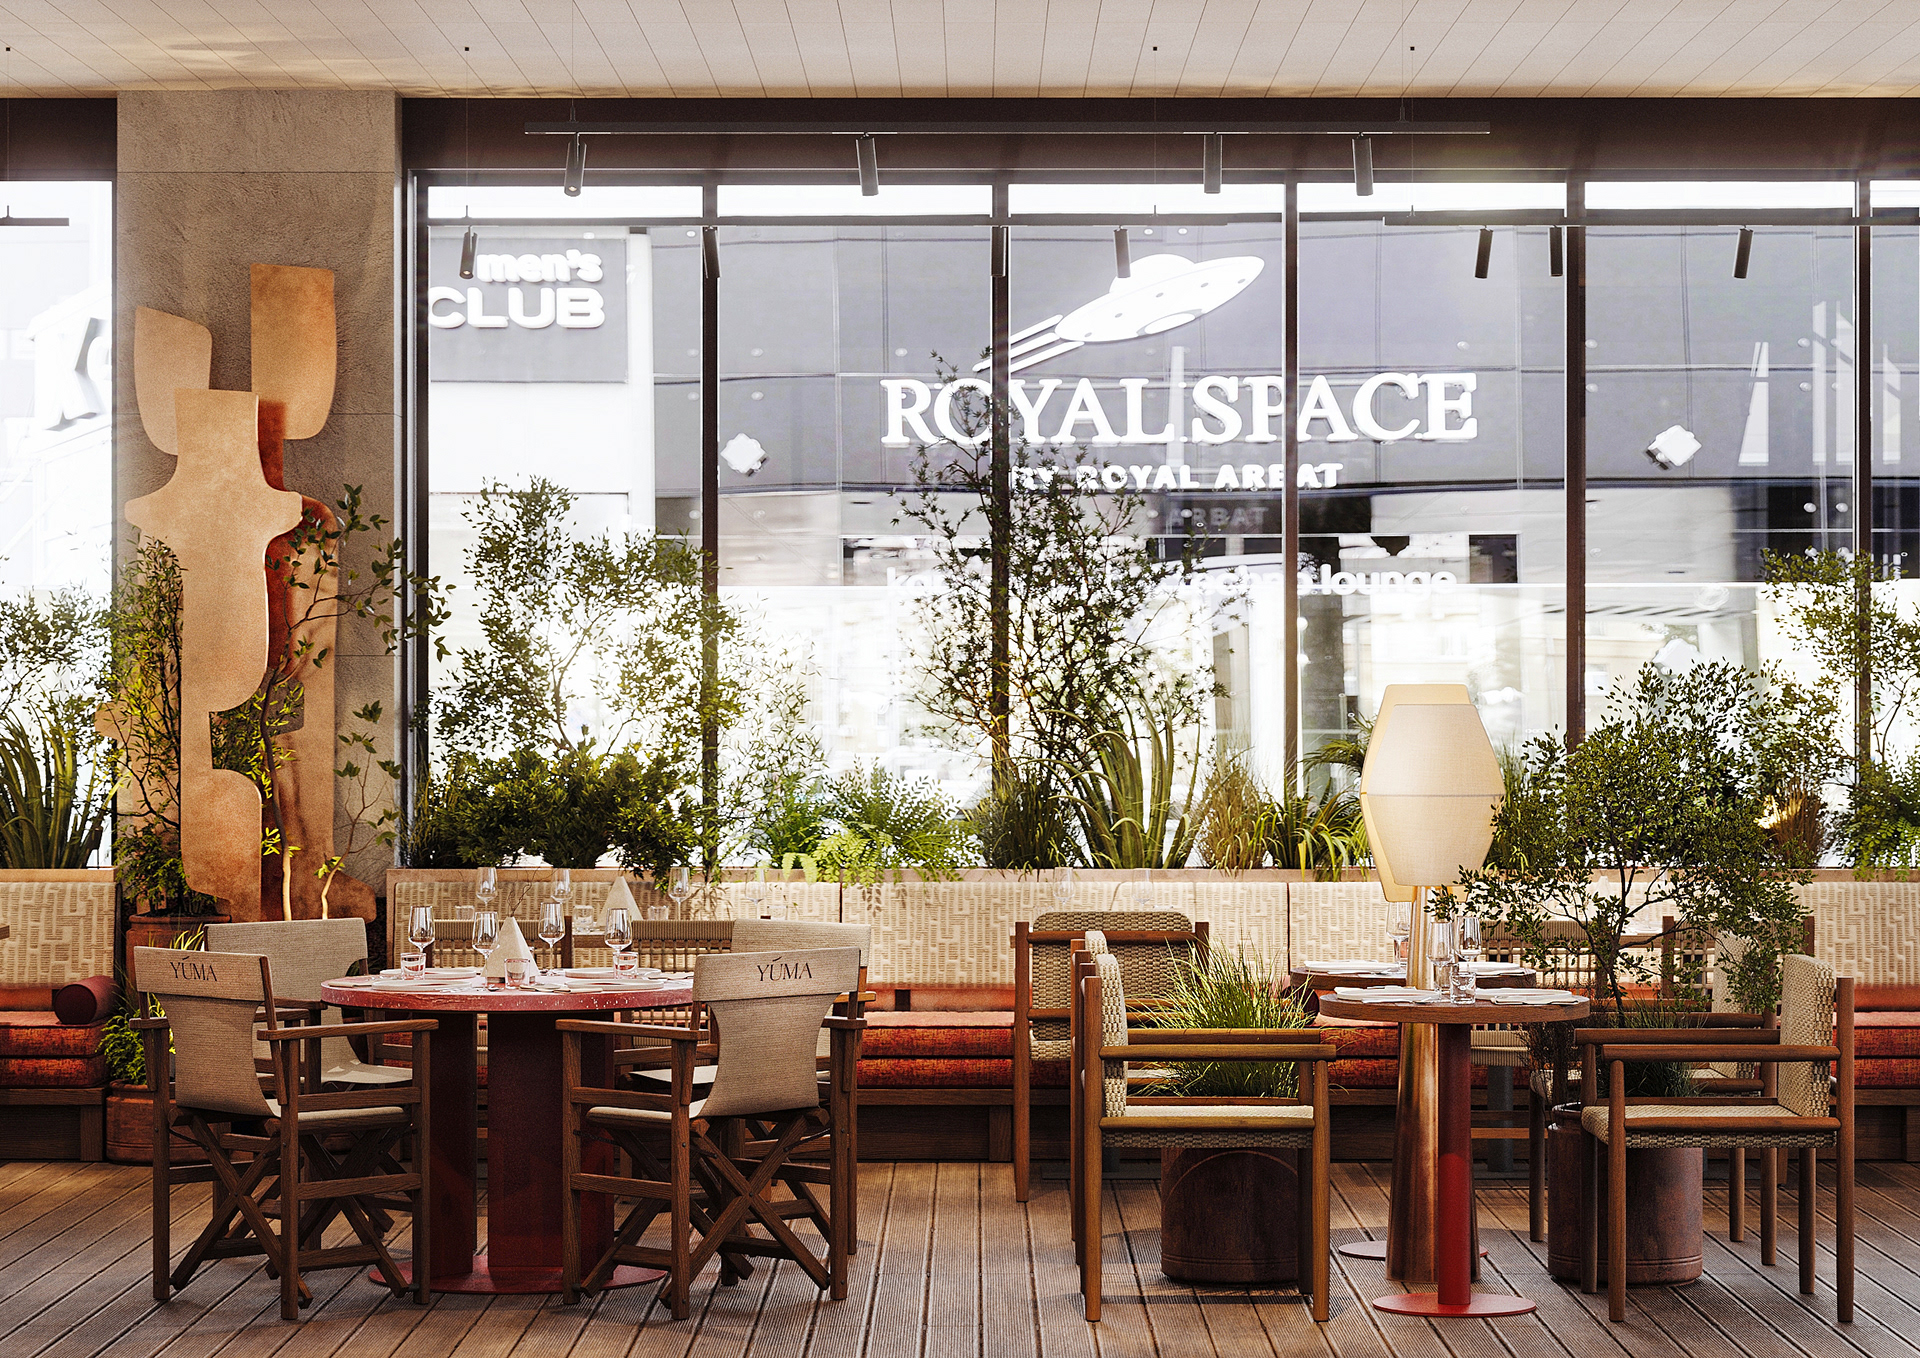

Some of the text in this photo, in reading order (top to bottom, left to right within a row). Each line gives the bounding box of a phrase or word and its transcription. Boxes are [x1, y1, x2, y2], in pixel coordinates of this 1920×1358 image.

[477, 249, 603, 282] men's
[428, 286, 605, 328] CLUB
[880, 372, 1477, 444] ROYAL SPACE
[1076, 464, 1200, 490] ROYAL
[1214, 462, 1343, 490] ARBAT
[1320, 563, 1457, 601] lounge
[170, 955, 218, 982] YÚMA
[757, 956, 813, 982] YÚMA
